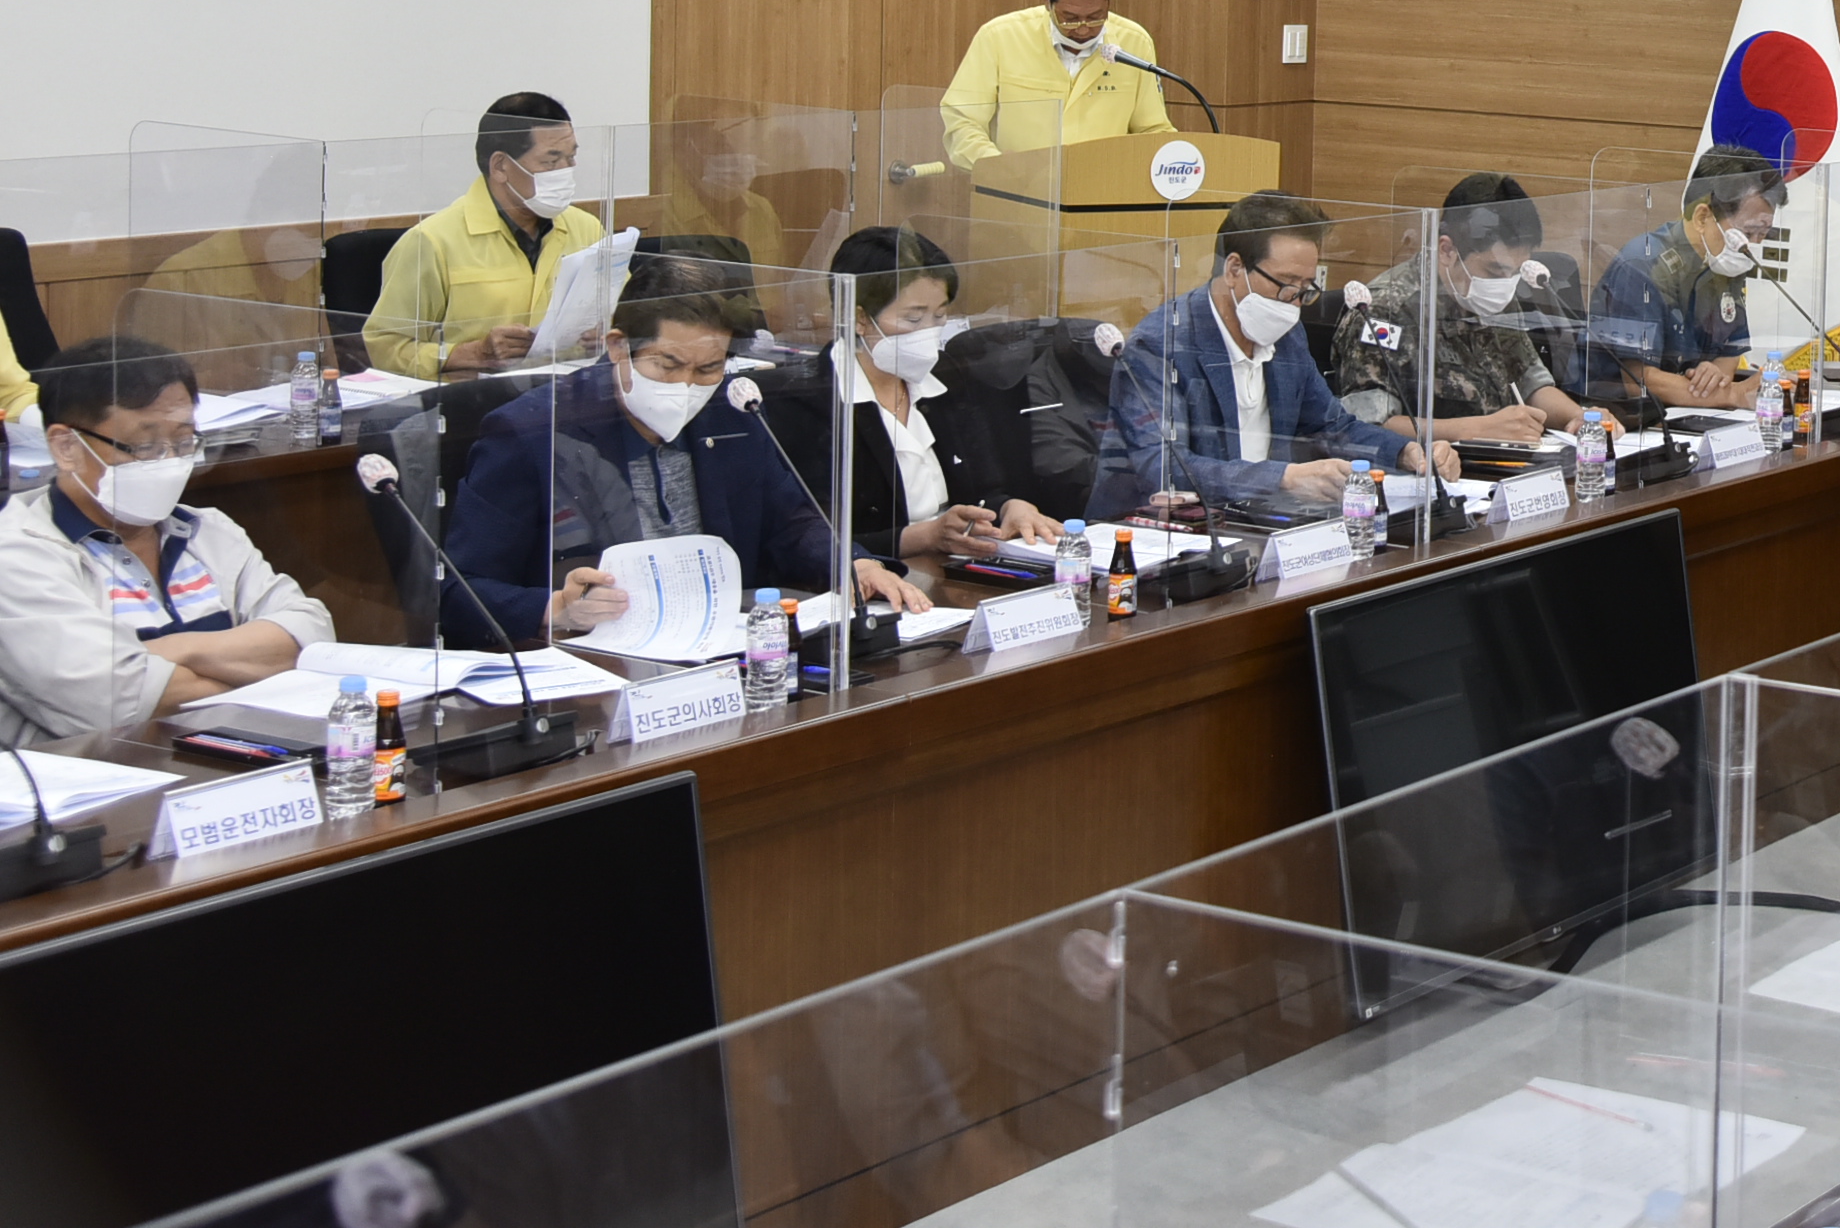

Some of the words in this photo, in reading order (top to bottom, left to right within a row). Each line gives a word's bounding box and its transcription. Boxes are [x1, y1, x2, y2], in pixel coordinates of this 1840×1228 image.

[1155, 163, 1193, 176] Jindo
[1509, 490, 1566, 517] 진도군번영회장
[1282, 544, 1351, 572] 진도군여성단체협의회장
[635, 691, 740, 734] 진도군의사회장
[180, 796, 316, 849] 모범운전자회장
